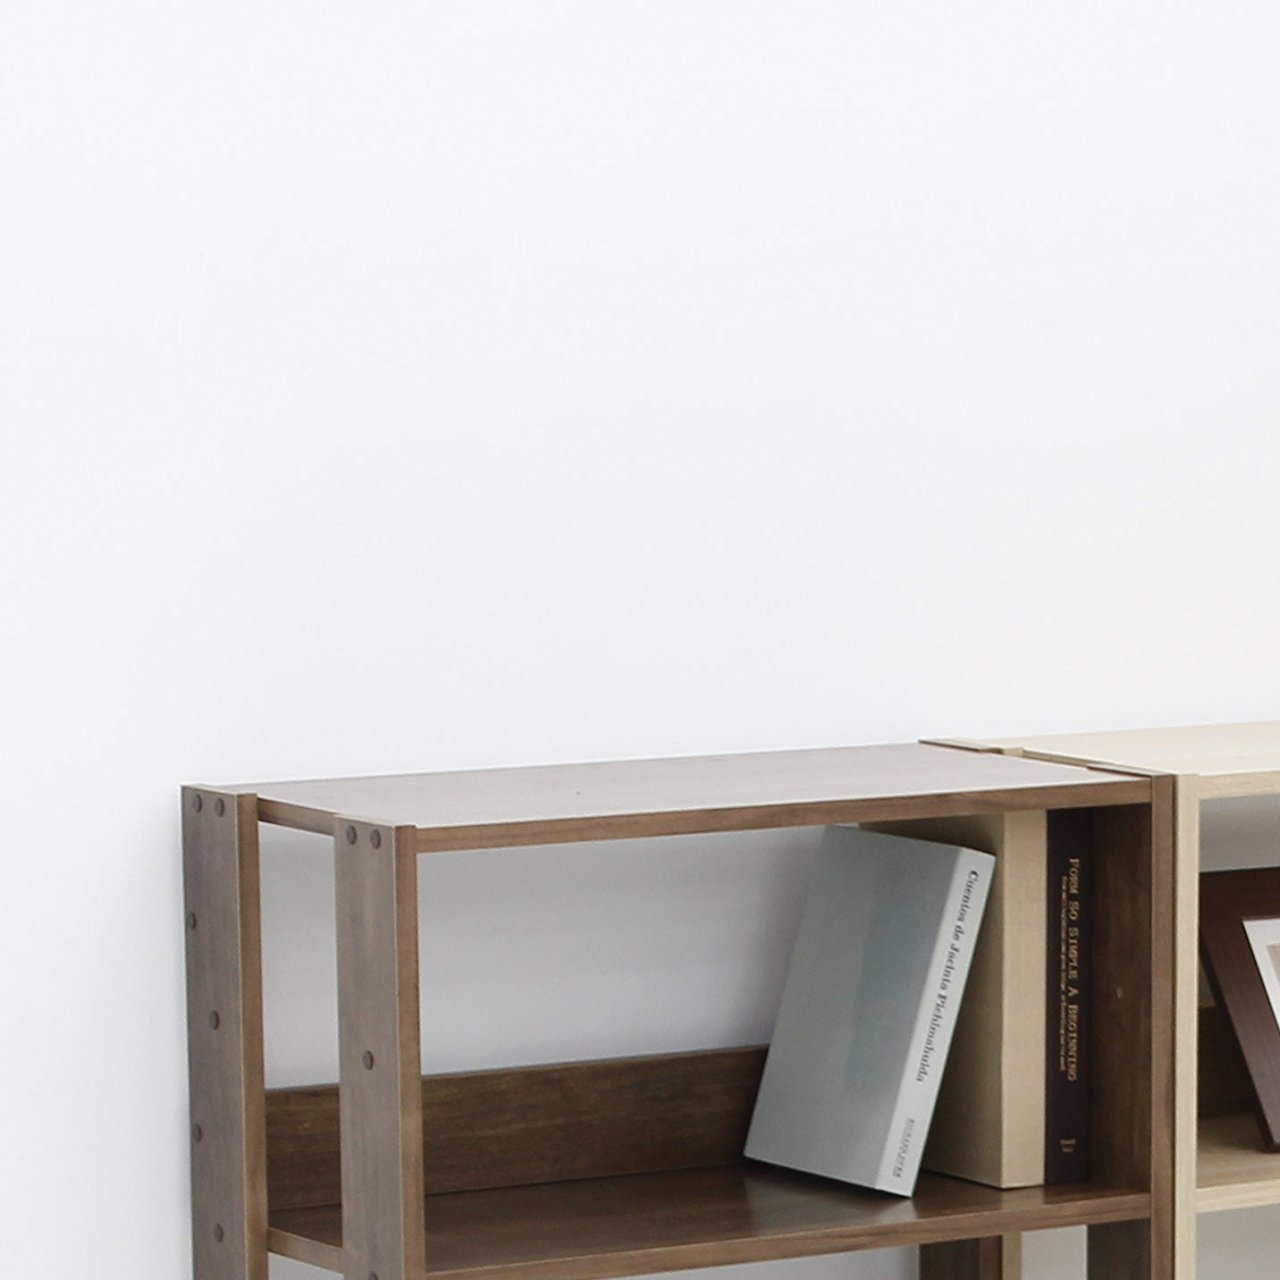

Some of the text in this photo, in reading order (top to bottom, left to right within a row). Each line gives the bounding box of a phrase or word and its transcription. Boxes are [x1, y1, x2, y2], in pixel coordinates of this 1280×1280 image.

[957, 869, 980, 922] Cuentos
[1068, 901, 1080, 920] SO
[952, 925, 966, 943] de
[1067, 927, 1080, 980] SIMPLE
[940, 943, 962, 991] Jacinta
[1067, 985, 1079, 997] A
[1067, 1004, 1079, 1082] BEGINNING
